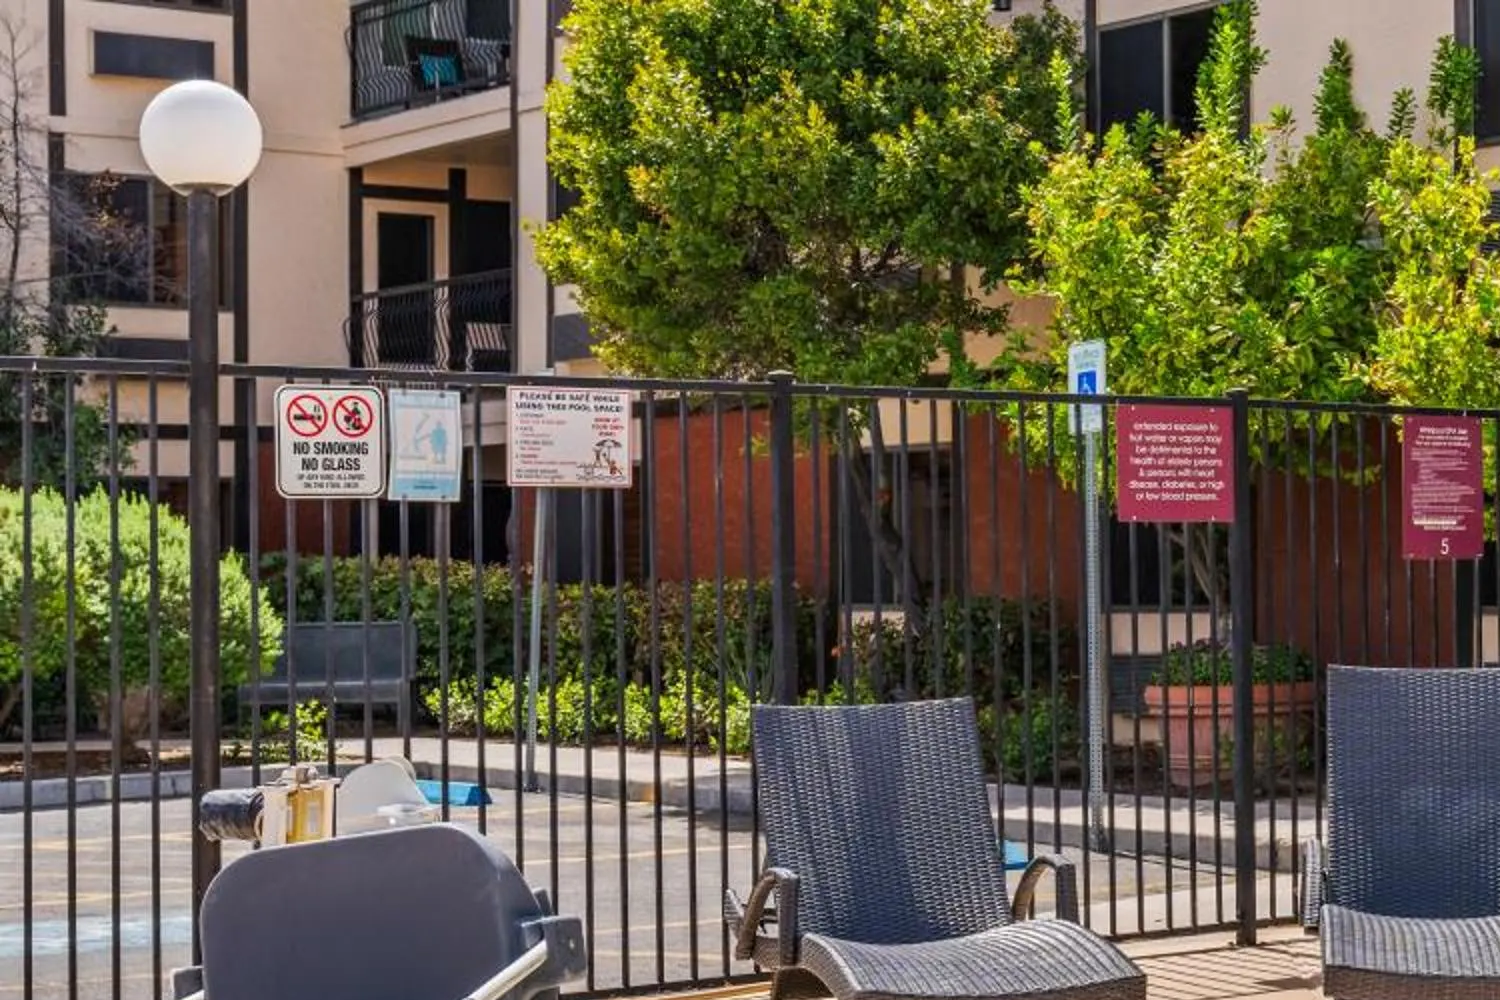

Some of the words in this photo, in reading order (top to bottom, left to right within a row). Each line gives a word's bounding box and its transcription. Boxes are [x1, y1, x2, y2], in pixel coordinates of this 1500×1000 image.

[1133, 422, 1172, 431] extended
[1173, 423, 1208, 432] exposure
[1129, 433, 1143, 442] hot
[1144, 434, 1167, 443] water
[1206, 435, 1222, 445] may
[293, 441, 310, 455] NO
[314, 441, 368, 455] SMOKING
[302, 457, 318, 471] NO
[321, 457, 361, 471] GLASS
[1160, 491, 1185, 501] blood
[1440, 538, 1450, 556] 5
